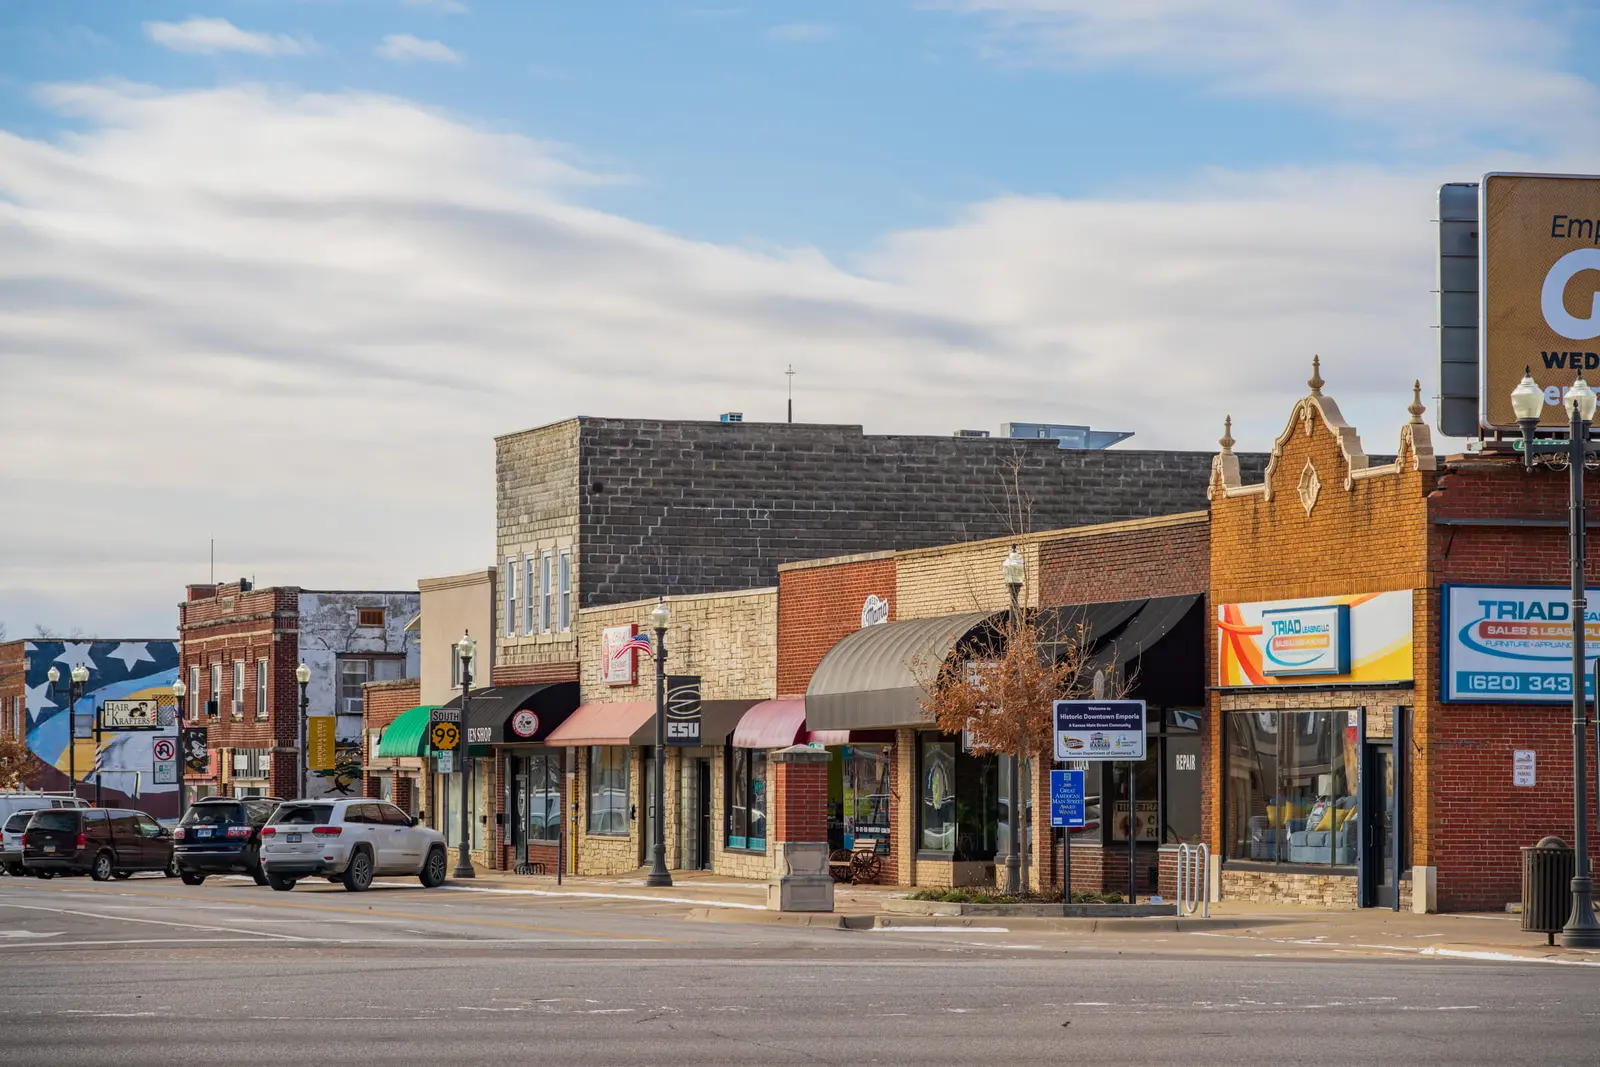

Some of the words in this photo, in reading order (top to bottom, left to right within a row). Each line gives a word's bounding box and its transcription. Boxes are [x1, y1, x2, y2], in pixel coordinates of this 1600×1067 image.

[1541, 351, 1600, 370] WED
[1478, 600, 1569, 620] TRIAD
[1272, 619, 1301, 635] TRIAD
[1302, 625, 1321, 634] LEASING
[1487, 626, 1528, 635] SALES
[1529, 627, 1539, 636] &
[1540, 627, 1573, 636] LEAS
[1485, 640, 1530, 648] FURNITURE
[1469, 675, 1520, 690] (620)
[1528, 676, 1571, 691] 343
[106, 703, 130, 716] HAIR
[433, 710, 459, 721] SOUTH
[1115, 713, 1140, 721] Emporia
[111, 711, 151, 726] KRAFTERS
[435, 727, 458, 744] 99
[477, 728, 492, 742] SHOP
[667, 722, 700, 738] ESU
[1176, 754, 1196, 770] REPAIR
